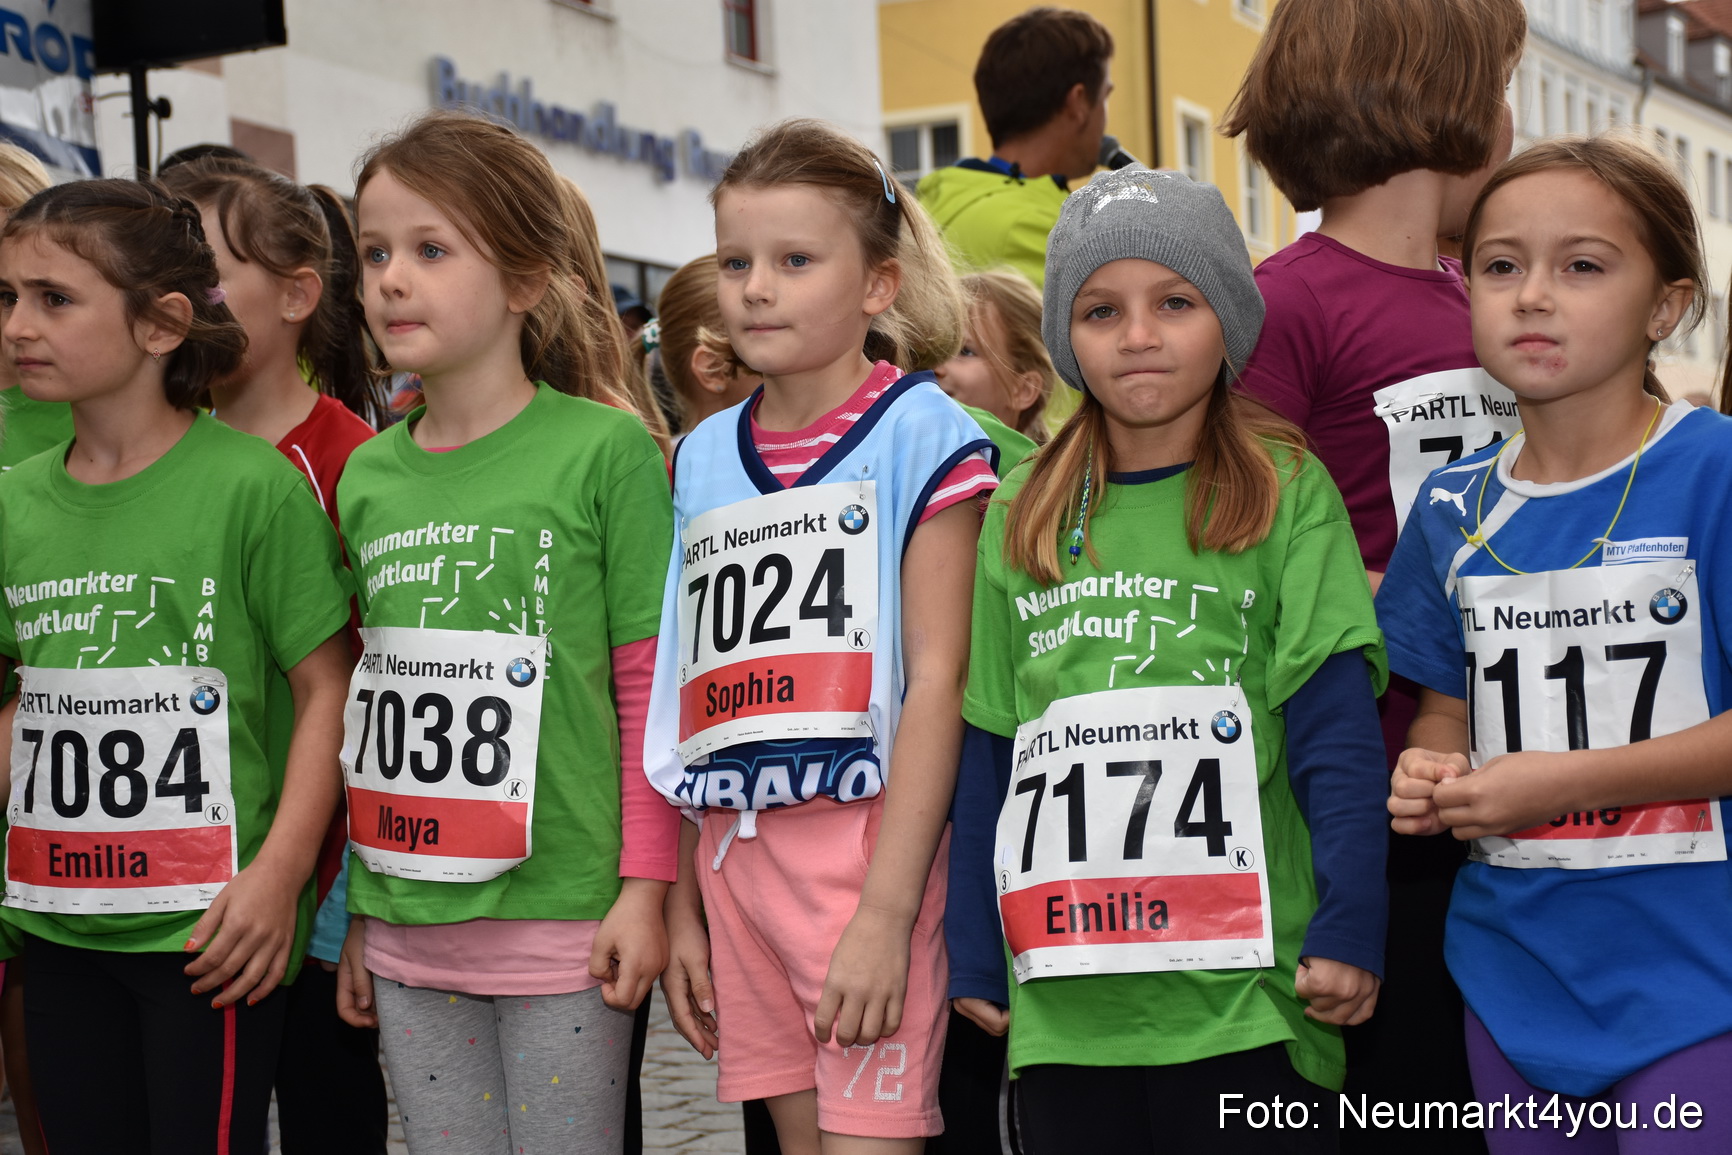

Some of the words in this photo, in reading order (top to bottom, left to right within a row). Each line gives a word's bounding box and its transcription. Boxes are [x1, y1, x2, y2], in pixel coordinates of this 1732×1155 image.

[1391, 395, 1476, 423] PARTL
[361, 521, 479, 568] Neumarkter
[724, 512, 827, 551] Neumarkt
[1606, 546, 1626, 556] MTV
[1627, 542, 1685, 554] Pfaffenhofen
[4, 570, 138, 608] Neumarkter
[688, 548, 853, 665] 7024
[1015, 571, 1178, 621] Neumarkter
[1028, 609, 1140, 658] Stadlauf
[1494, 599, 1636, 631] Neumarkt
[386, 654, 494, 680] Neumarkt
[58, 692, 180, 715] Neumarkt
[706, 669, 795, 718] Sophia
[355, 689, 513, 787] 7038
[1065, 716, 1200, 748] Neumarkt
[22, 727, 210, 818] 7084
[377, 805, 439, 851] Maya
[1015, 758, 1233, 874] 7174
[49, 843, 148, 878] Emilia
[1046, 892, 1169, 935] Emilia
[842, 1042, 907, 1102] 72
